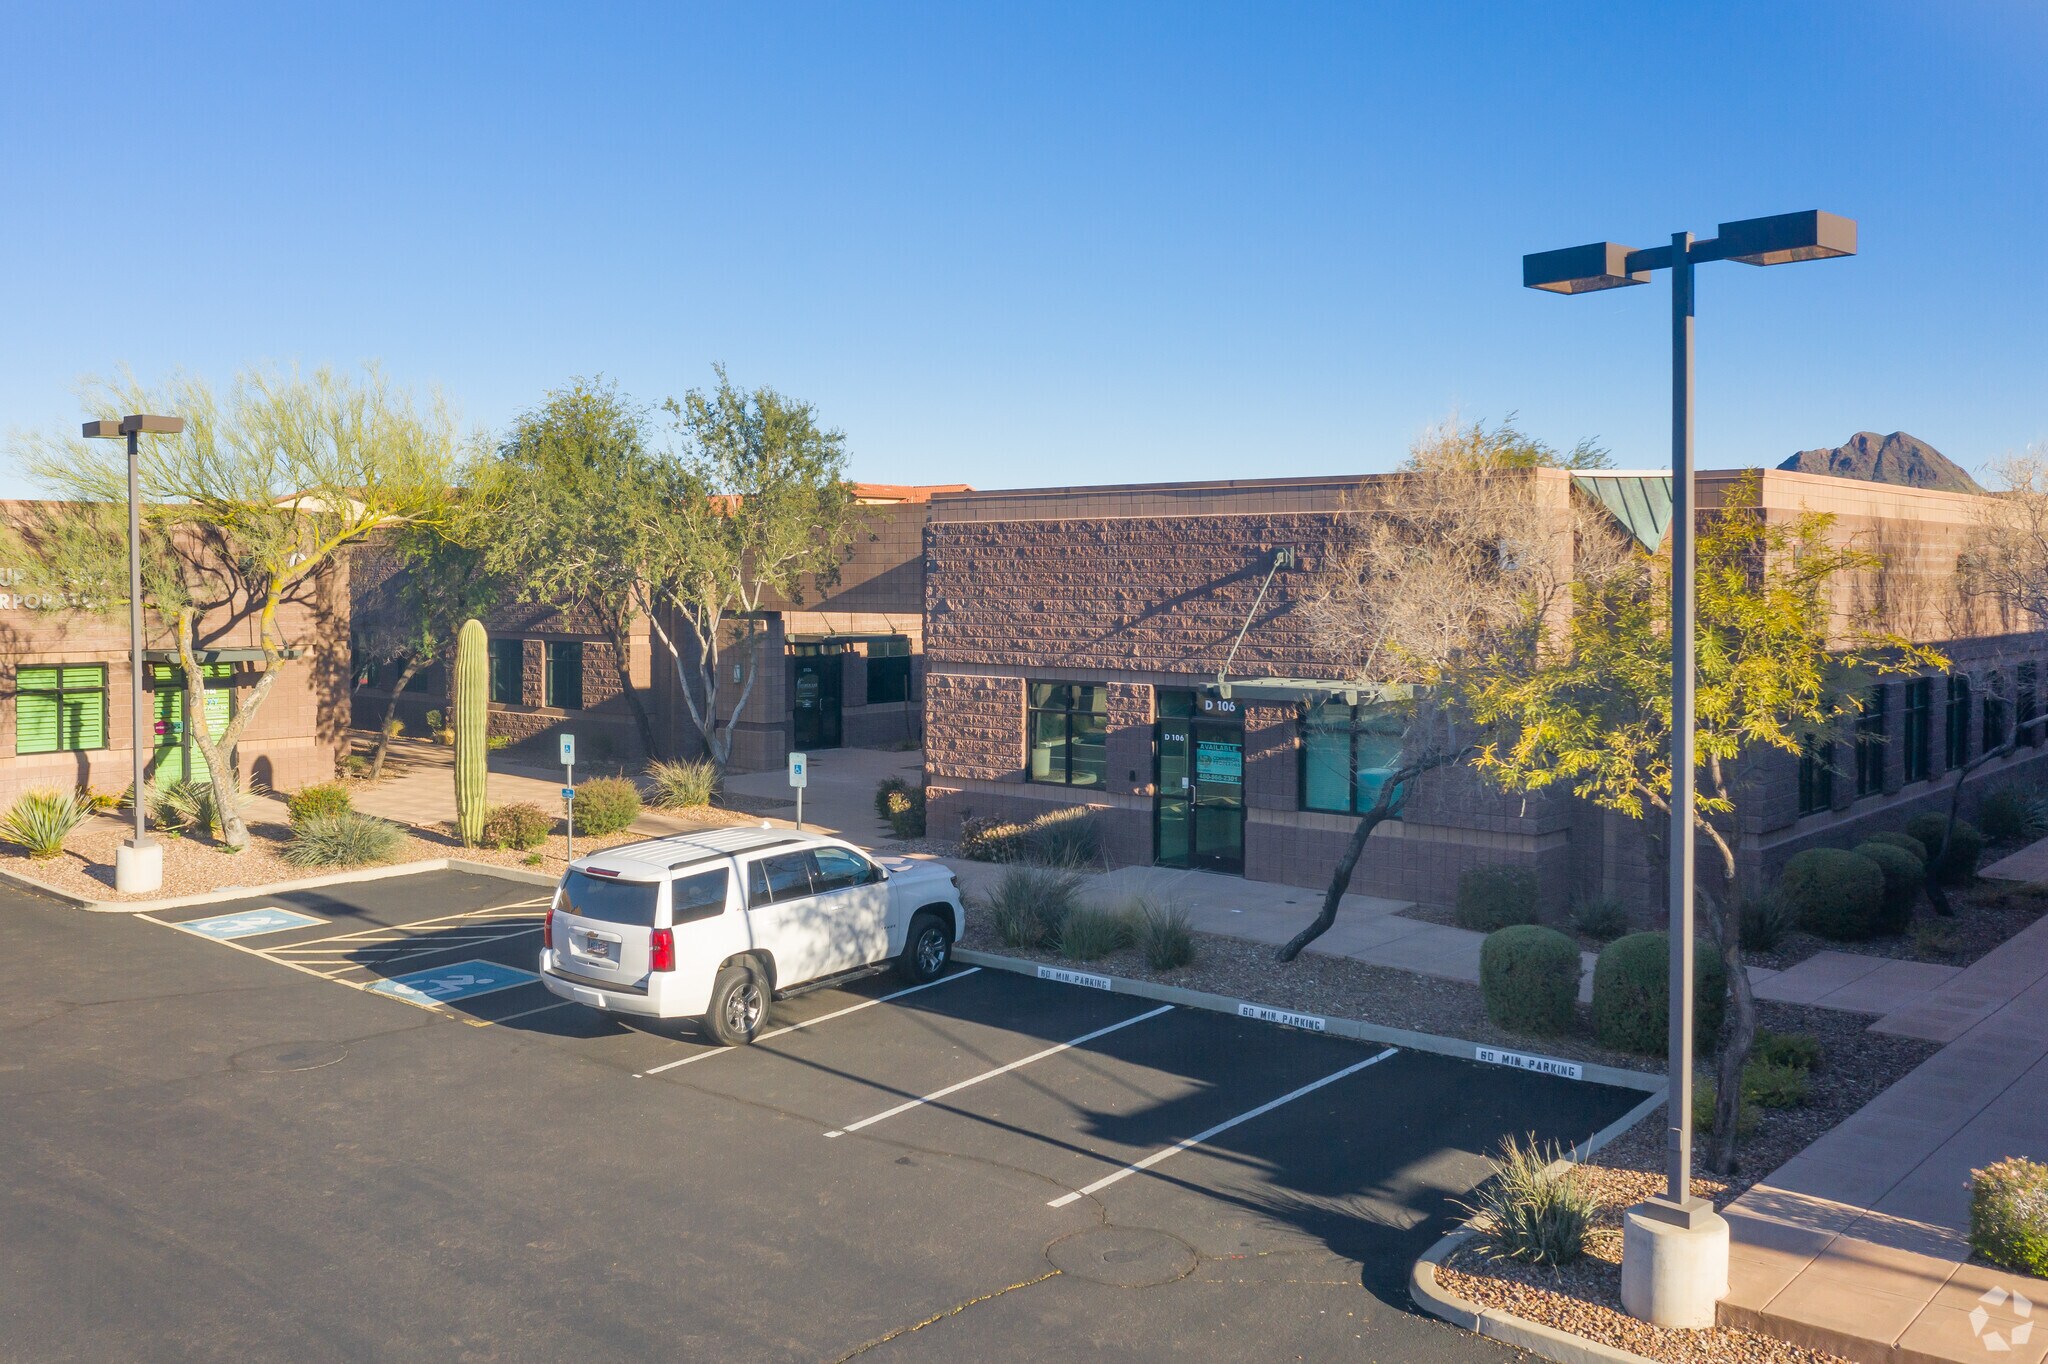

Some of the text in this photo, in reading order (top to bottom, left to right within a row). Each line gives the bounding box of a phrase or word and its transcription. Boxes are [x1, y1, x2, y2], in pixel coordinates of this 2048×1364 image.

[1205, 700, 1235, 712] D 106
[1200, 743, 1237, 752] AVAILABLE
[1041, 969, 1107, 989] 60 MIN. PARKING
[1243, 1007, 1320, 1030] 60 MIN. PARKING
[1480, 1050, 1575, 1077] 60 MIN. PARKING
